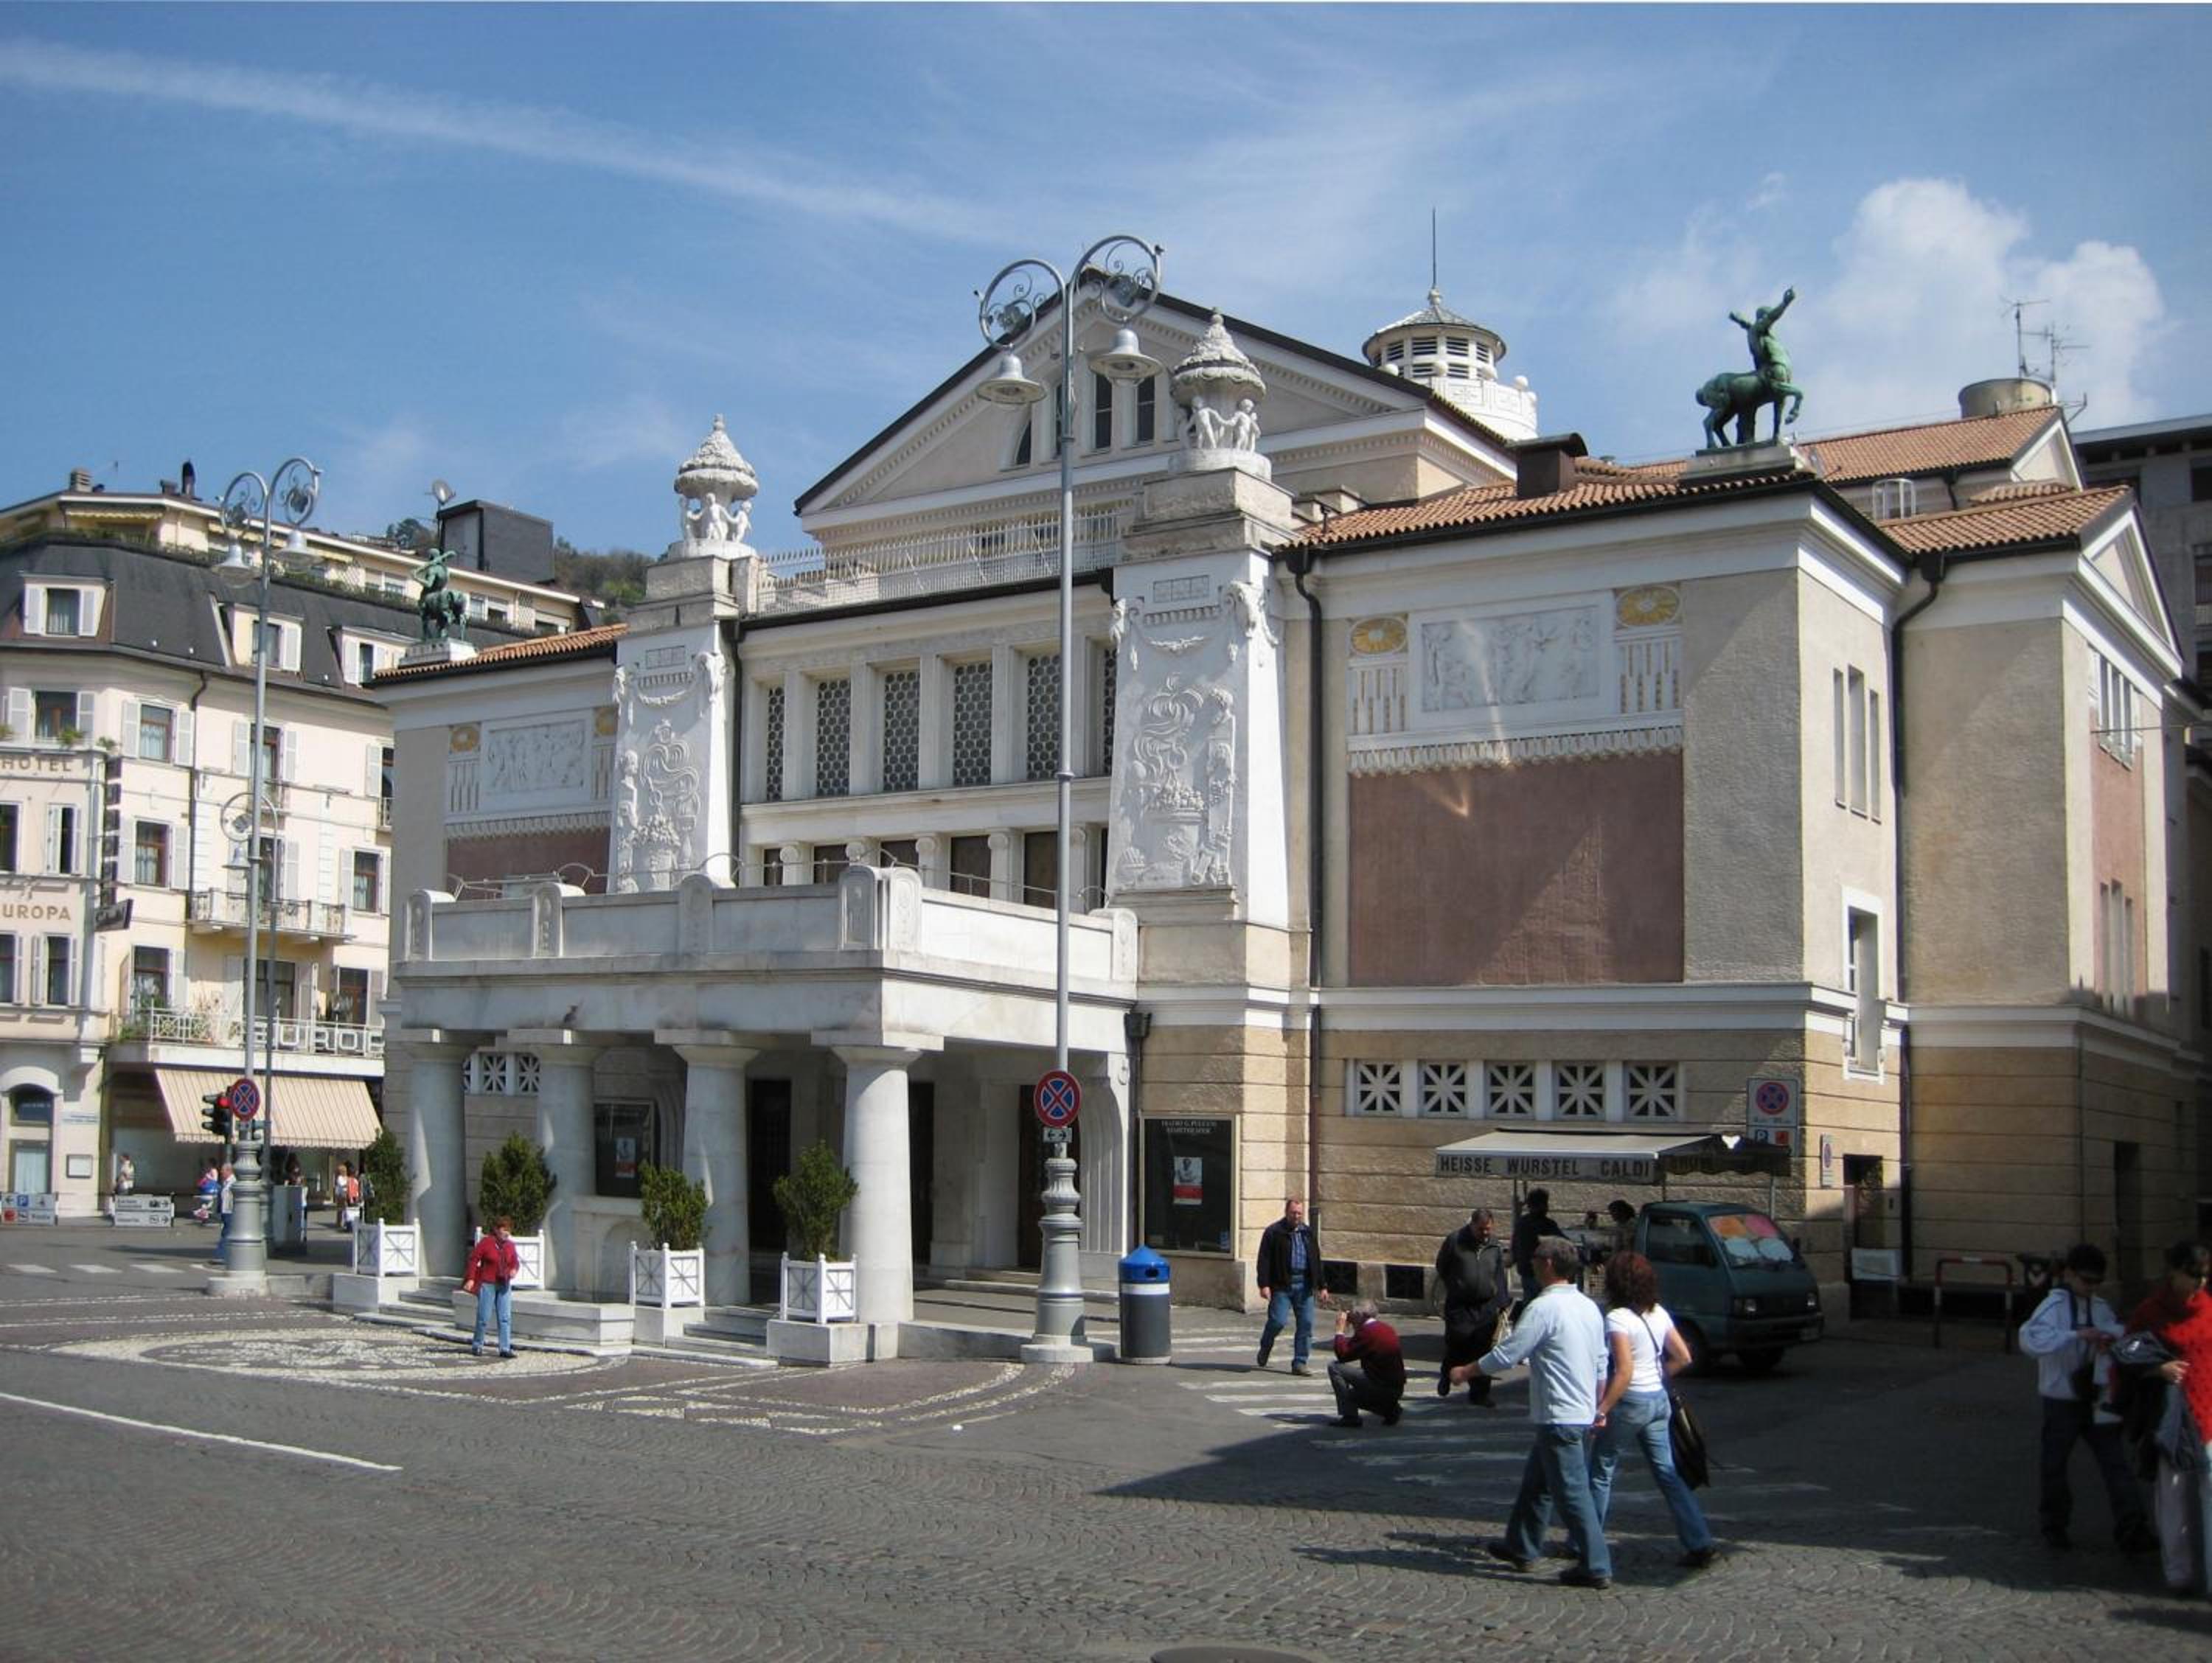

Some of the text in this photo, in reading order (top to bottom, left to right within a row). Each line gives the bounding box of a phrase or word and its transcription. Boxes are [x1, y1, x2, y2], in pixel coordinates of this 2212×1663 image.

[2, 756, 72, 772] HOTEL
[1440, 1156, 1492, 1174] HEISSE
[1507, 1157, 1579, 1176] WURSTEL
[1600, 1160, 1649, 1177] CALDI
